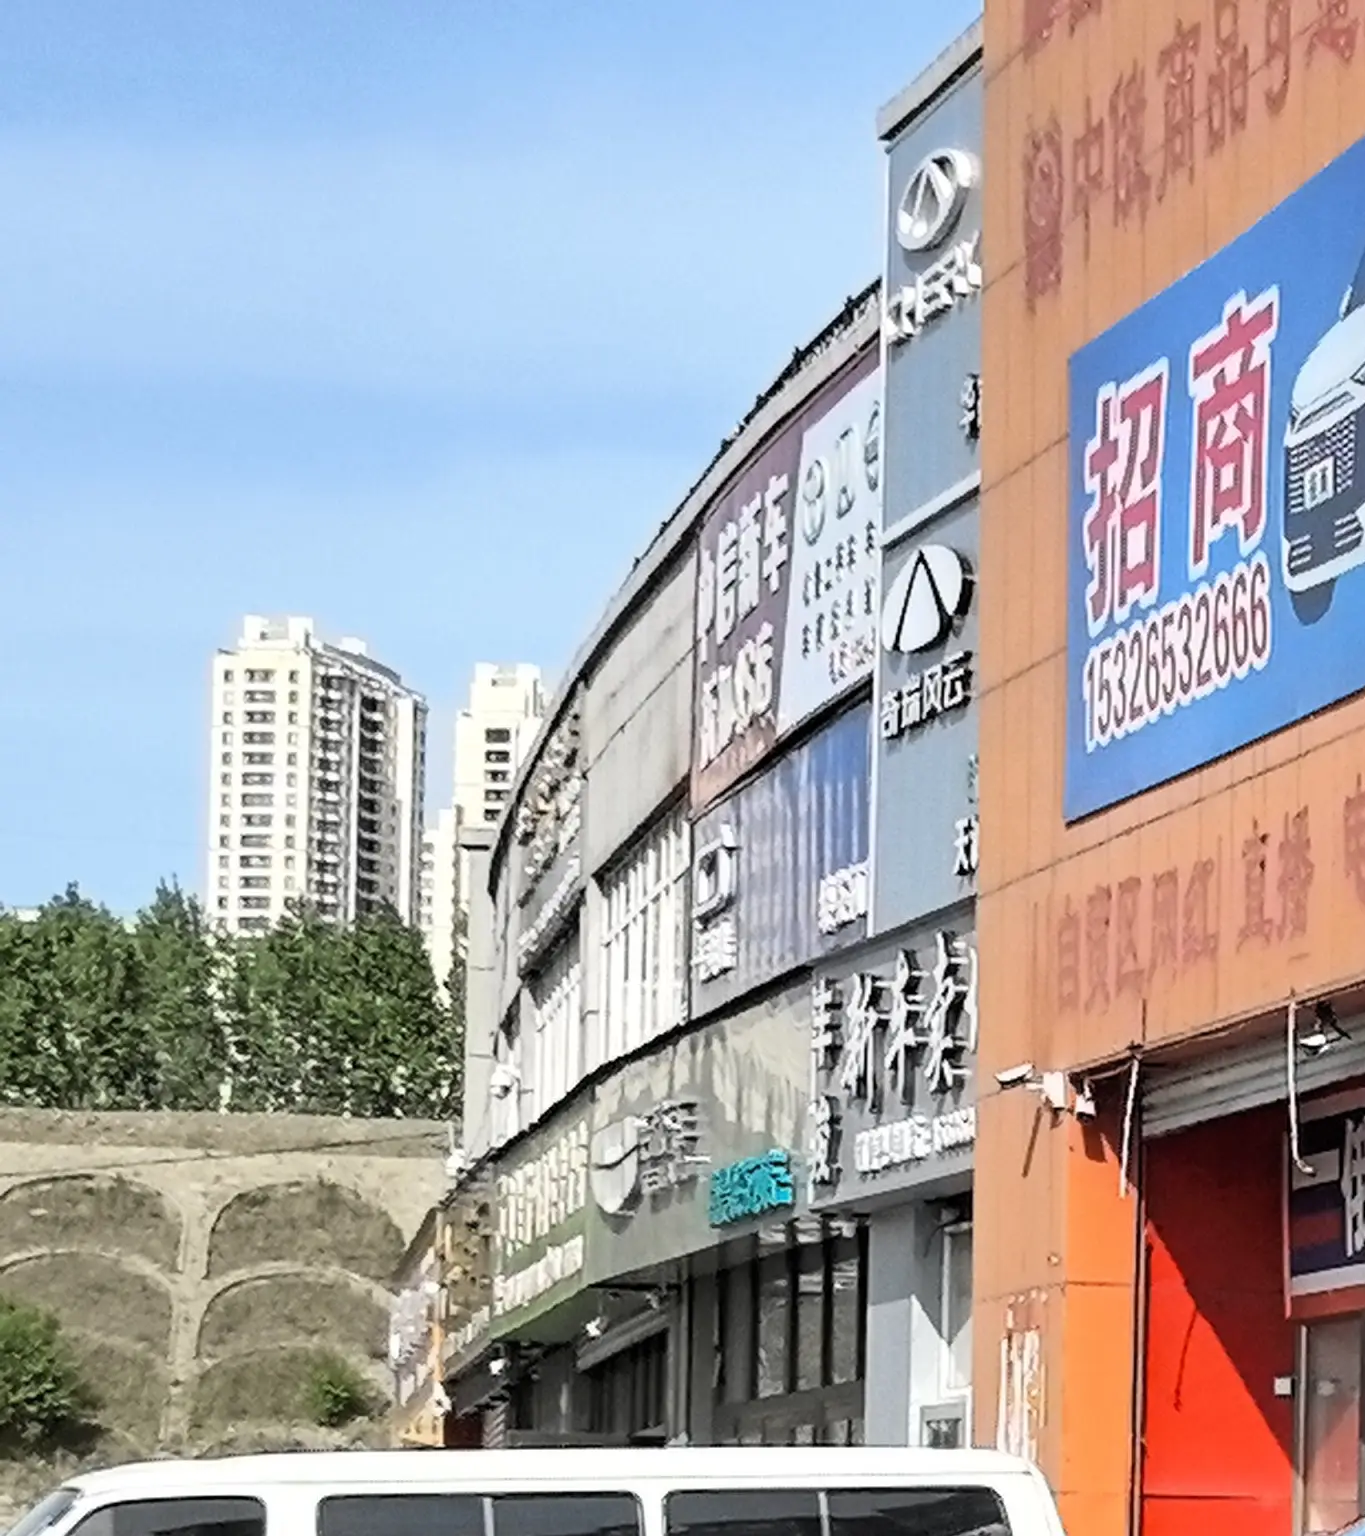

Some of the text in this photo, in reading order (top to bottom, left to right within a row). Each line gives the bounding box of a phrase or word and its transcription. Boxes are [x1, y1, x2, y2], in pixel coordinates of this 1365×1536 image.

[1085, 286, 1278, 634] 招商
[881, 651, 973, 739] 奇瑞风云
[1085, 553, 1269, 751] 15326532666
